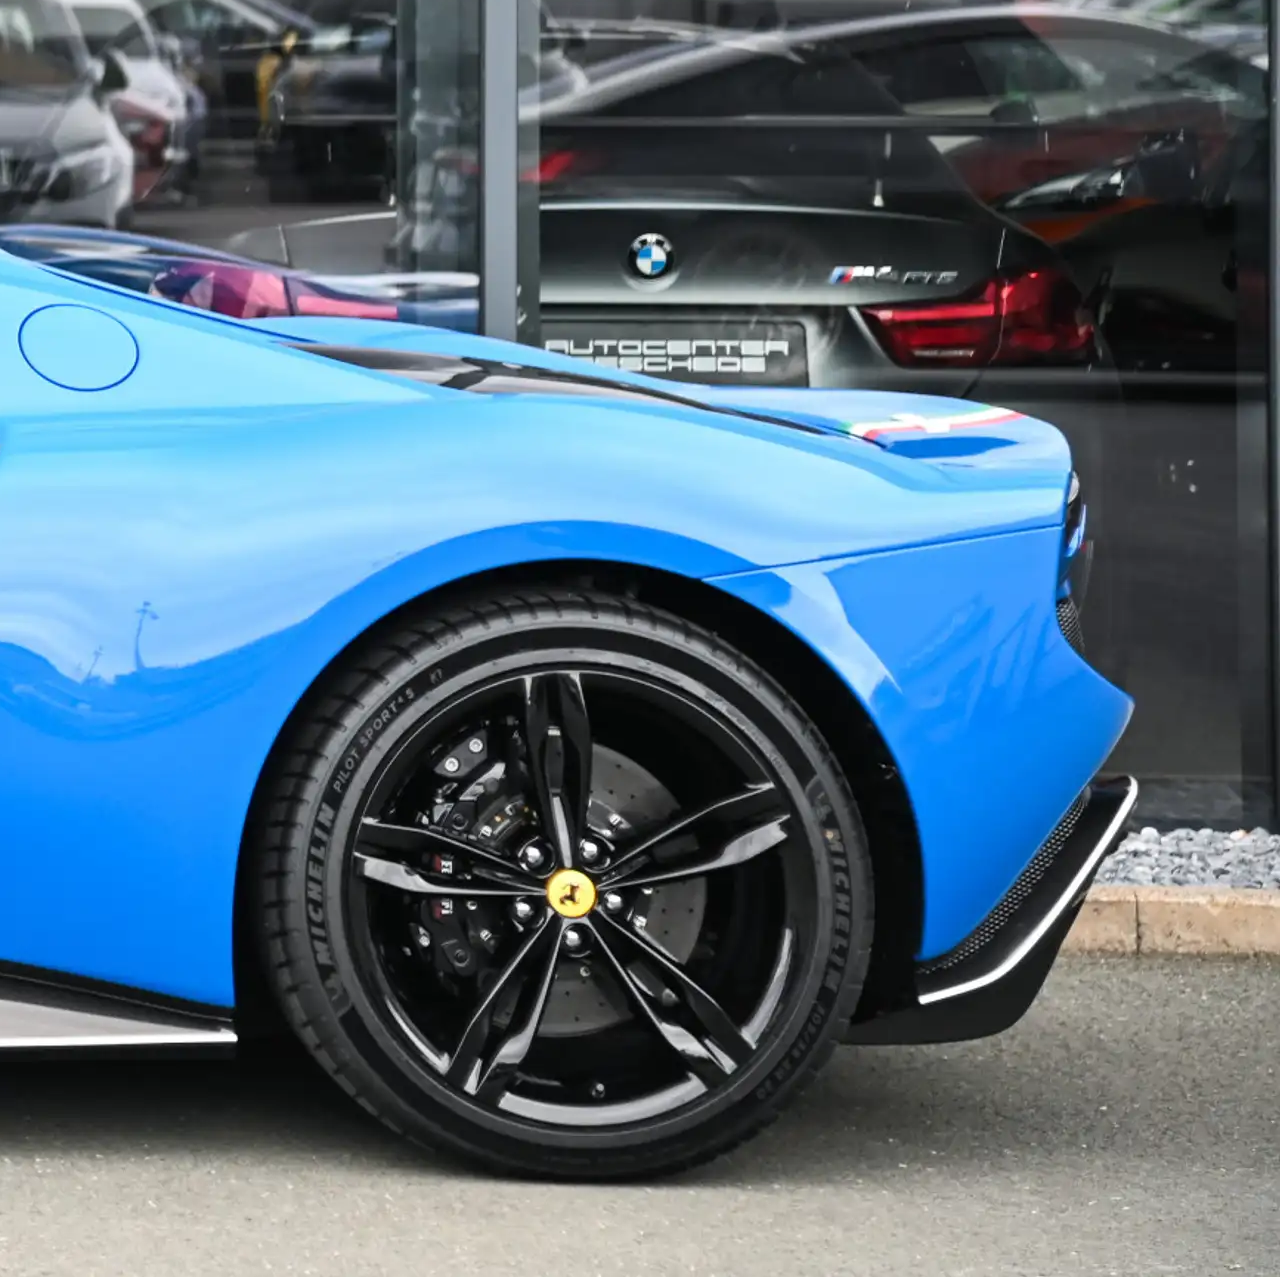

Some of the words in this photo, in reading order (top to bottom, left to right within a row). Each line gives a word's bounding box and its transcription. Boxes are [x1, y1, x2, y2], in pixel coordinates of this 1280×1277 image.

[544, 339, 789, 357] AUTOCENTER
[306, 801, 339, 969] MICHELIN
[329, 747, 362, 793] PILOT
[821, 824, 851, 993] MICHELIN
